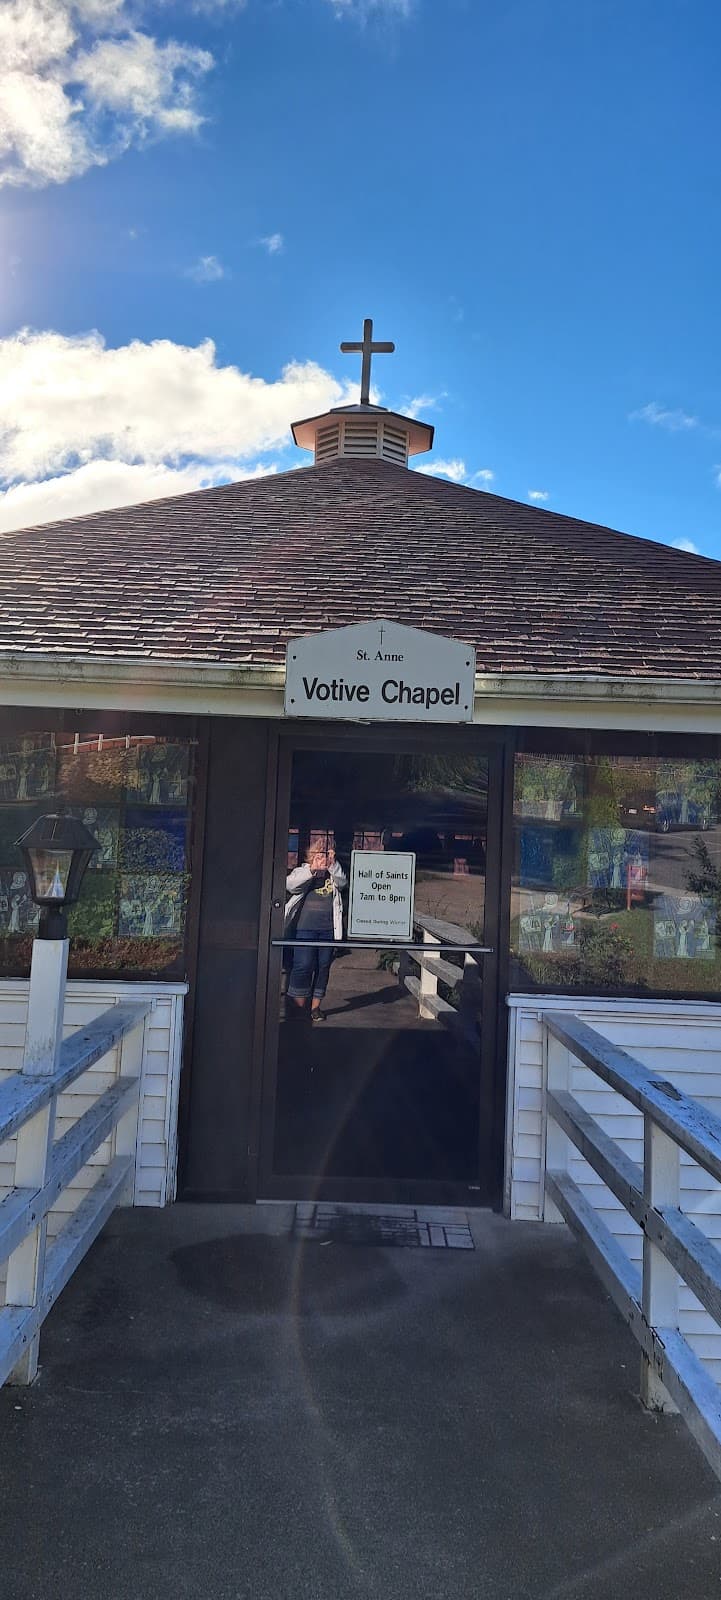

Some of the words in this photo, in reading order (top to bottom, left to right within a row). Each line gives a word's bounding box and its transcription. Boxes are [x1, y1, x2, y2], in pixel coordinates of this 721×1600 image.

[356, 650, 370, 661] St.
[374, 651, 404, 662] Anne
[302, 677, 370, 702] Votive
[381, 679, 460, 709] Chapel
[358, 870, 372, 879] Hall
[375, 870, 383, 879] of
[386, 871, 408, 880] Saints
[371, 882, 391, 891] Open
[360, 892, 375, 901] 7am
[389, 893, 406, 904] 8pm
